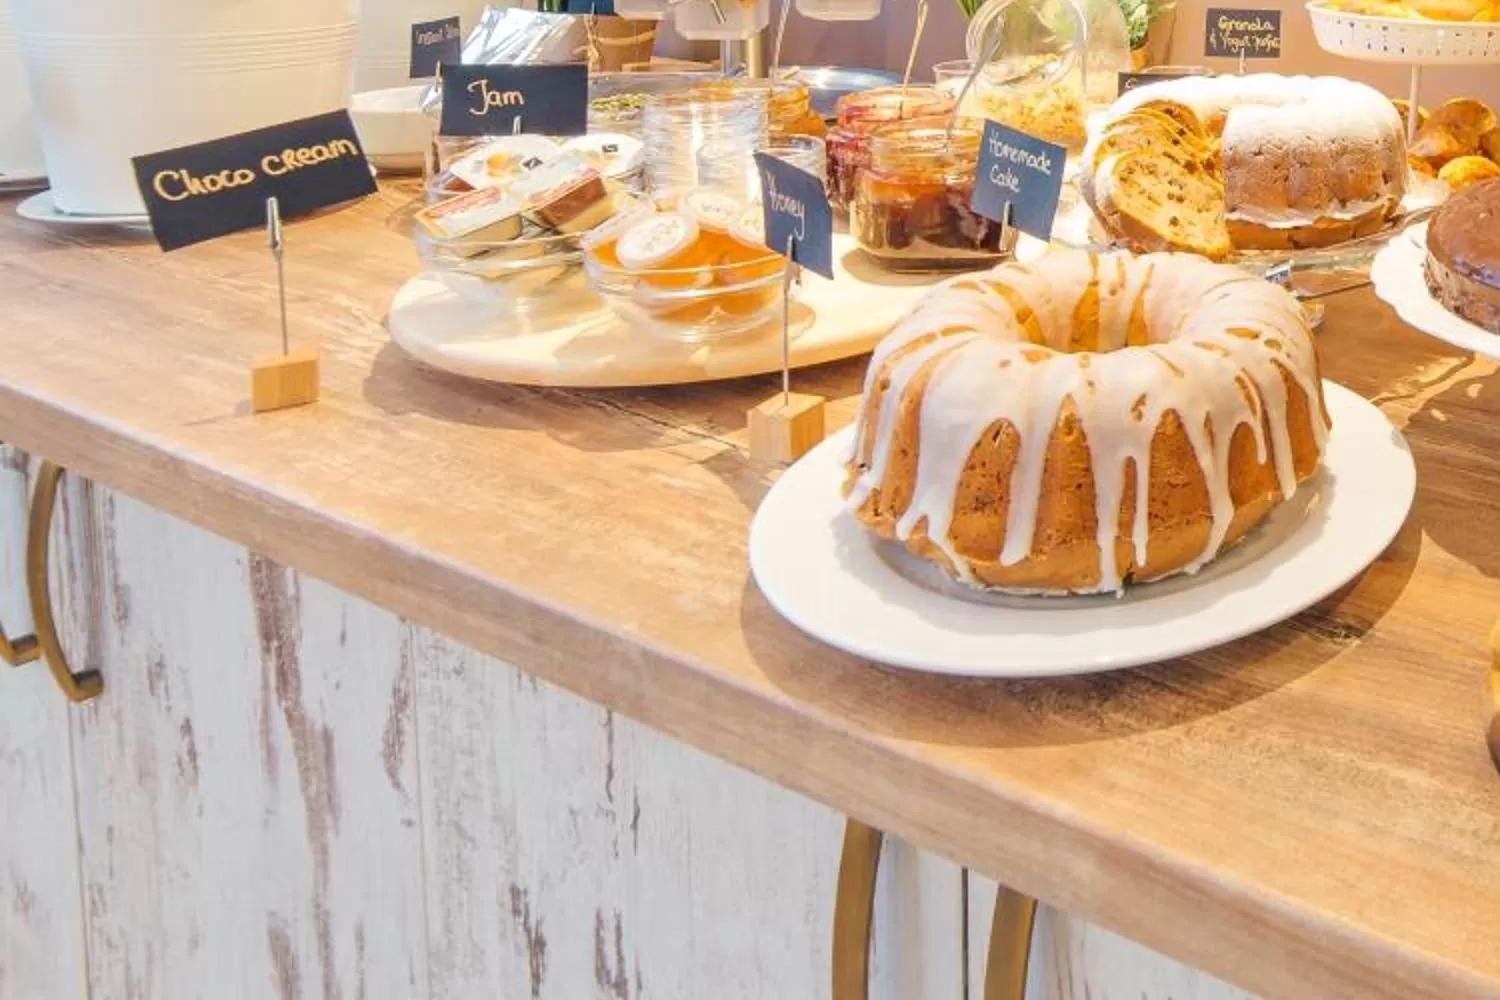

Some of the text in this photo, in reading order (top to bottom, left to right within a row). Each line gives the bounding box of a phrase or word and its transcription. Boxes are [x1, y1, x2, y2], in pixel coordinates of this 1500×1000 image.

[466, 78, 525, 116] Jam
[988, 128, 1053, 176] Homemade
[153, 168, 256, 201] Choco
[990, 163, 1021, 193] Cake
[765, 169, 805, 242] Honey
